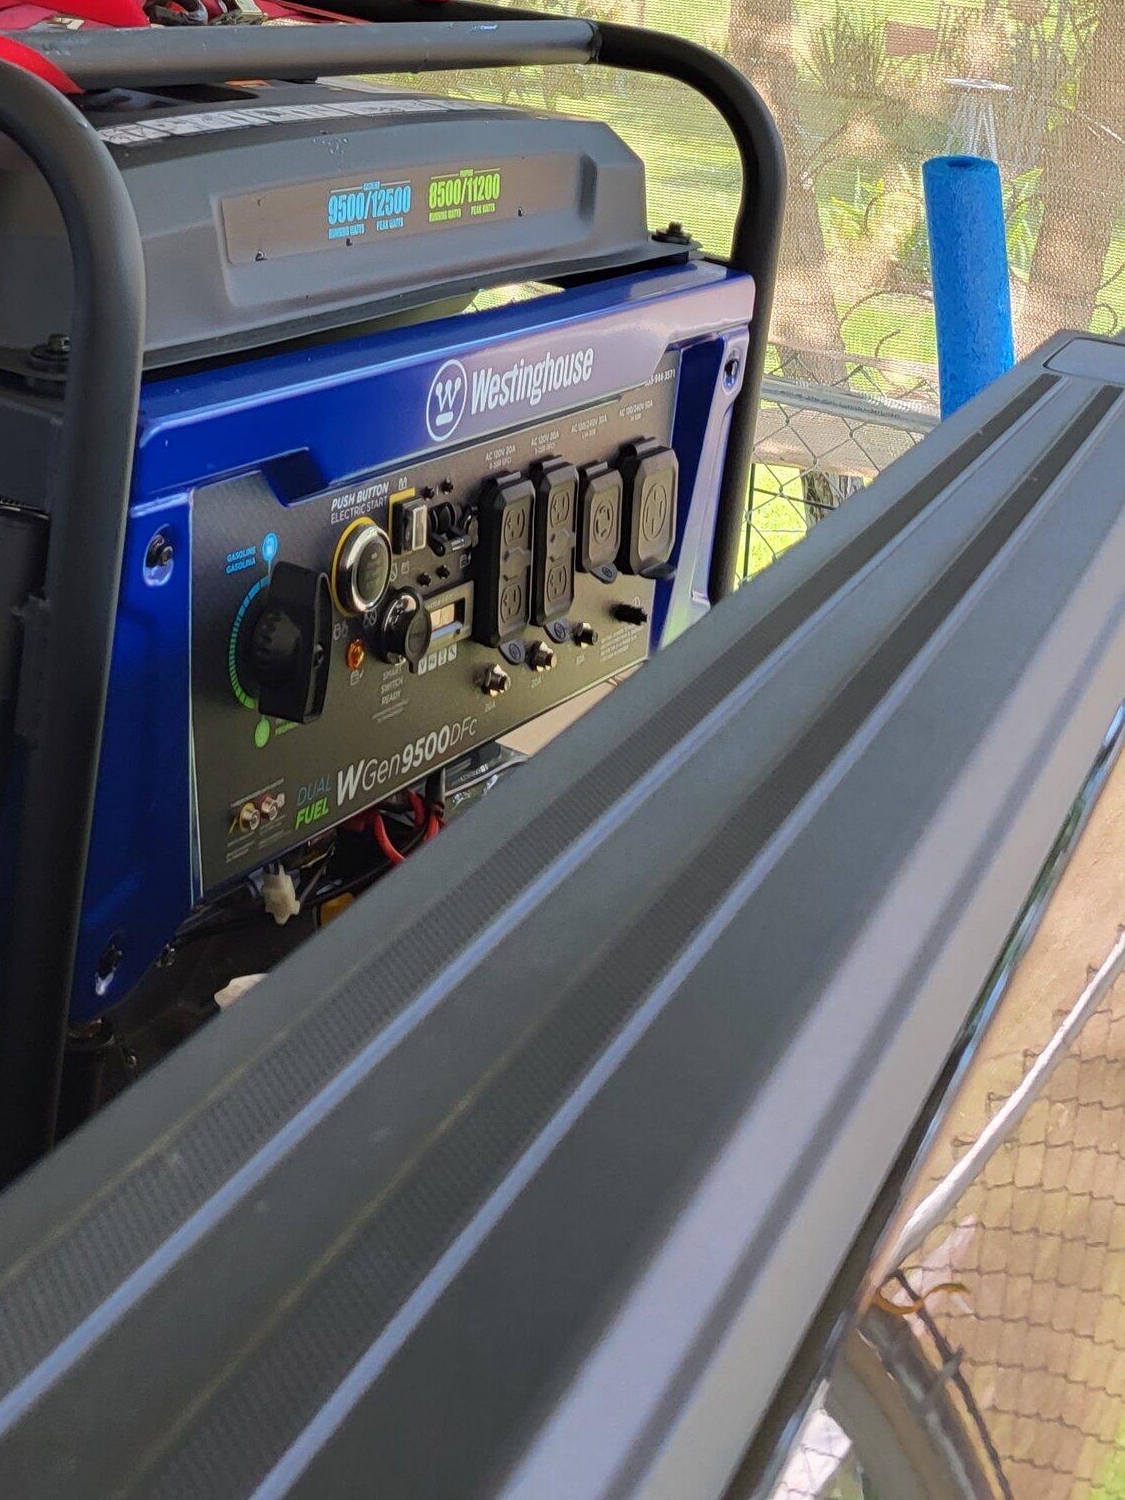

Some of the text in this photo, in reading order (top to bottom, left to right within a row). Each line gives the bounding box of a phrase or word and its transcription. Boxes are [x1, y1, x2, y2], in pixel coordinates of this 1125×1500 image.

[328, 185, 411, 225] 9500/12500
[429, 173, 500, 209] 8500/11200
[471, 348, 594, 416] Westinghouse
[331, 481, 389, 511] PUSH BUTTON
[331, 495, 388, 524] ELECTRIC START
[381, 689, 401, 705] READY
[297, 775, 332, 806] DUAL
[337, 716, 477, 806] WGen9500DFc
[295, 797, 329, 830] FUEL
